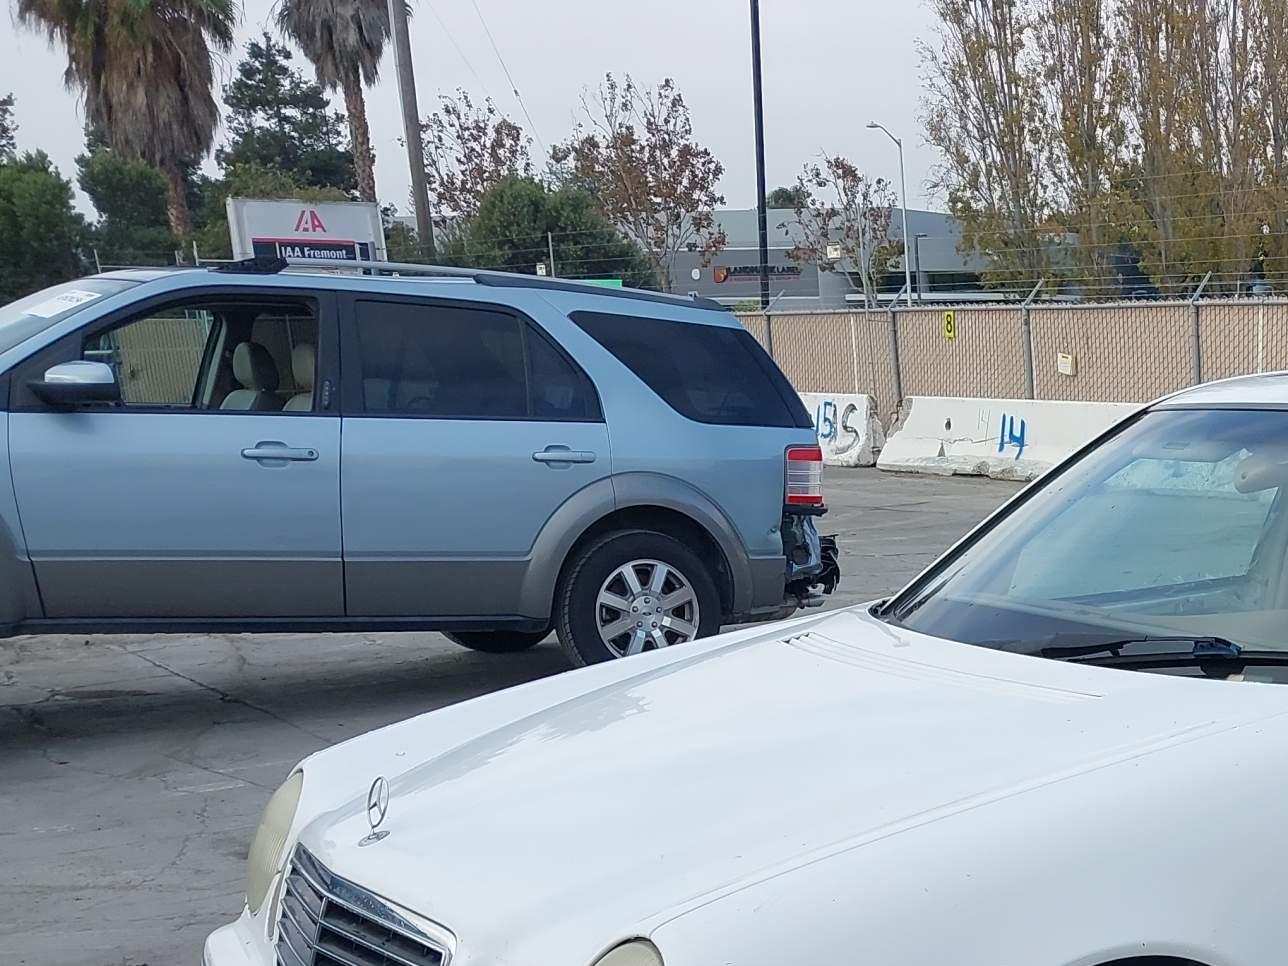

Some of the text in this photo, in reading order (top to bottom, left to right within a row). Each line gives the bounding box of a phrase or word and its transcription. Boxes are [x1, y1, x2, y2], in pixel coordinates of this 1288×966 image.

[280, 246, 347, 259] IAA Fremont
[945, 314, 953, 334] 8
[998, 412, 1027, 461] 14
